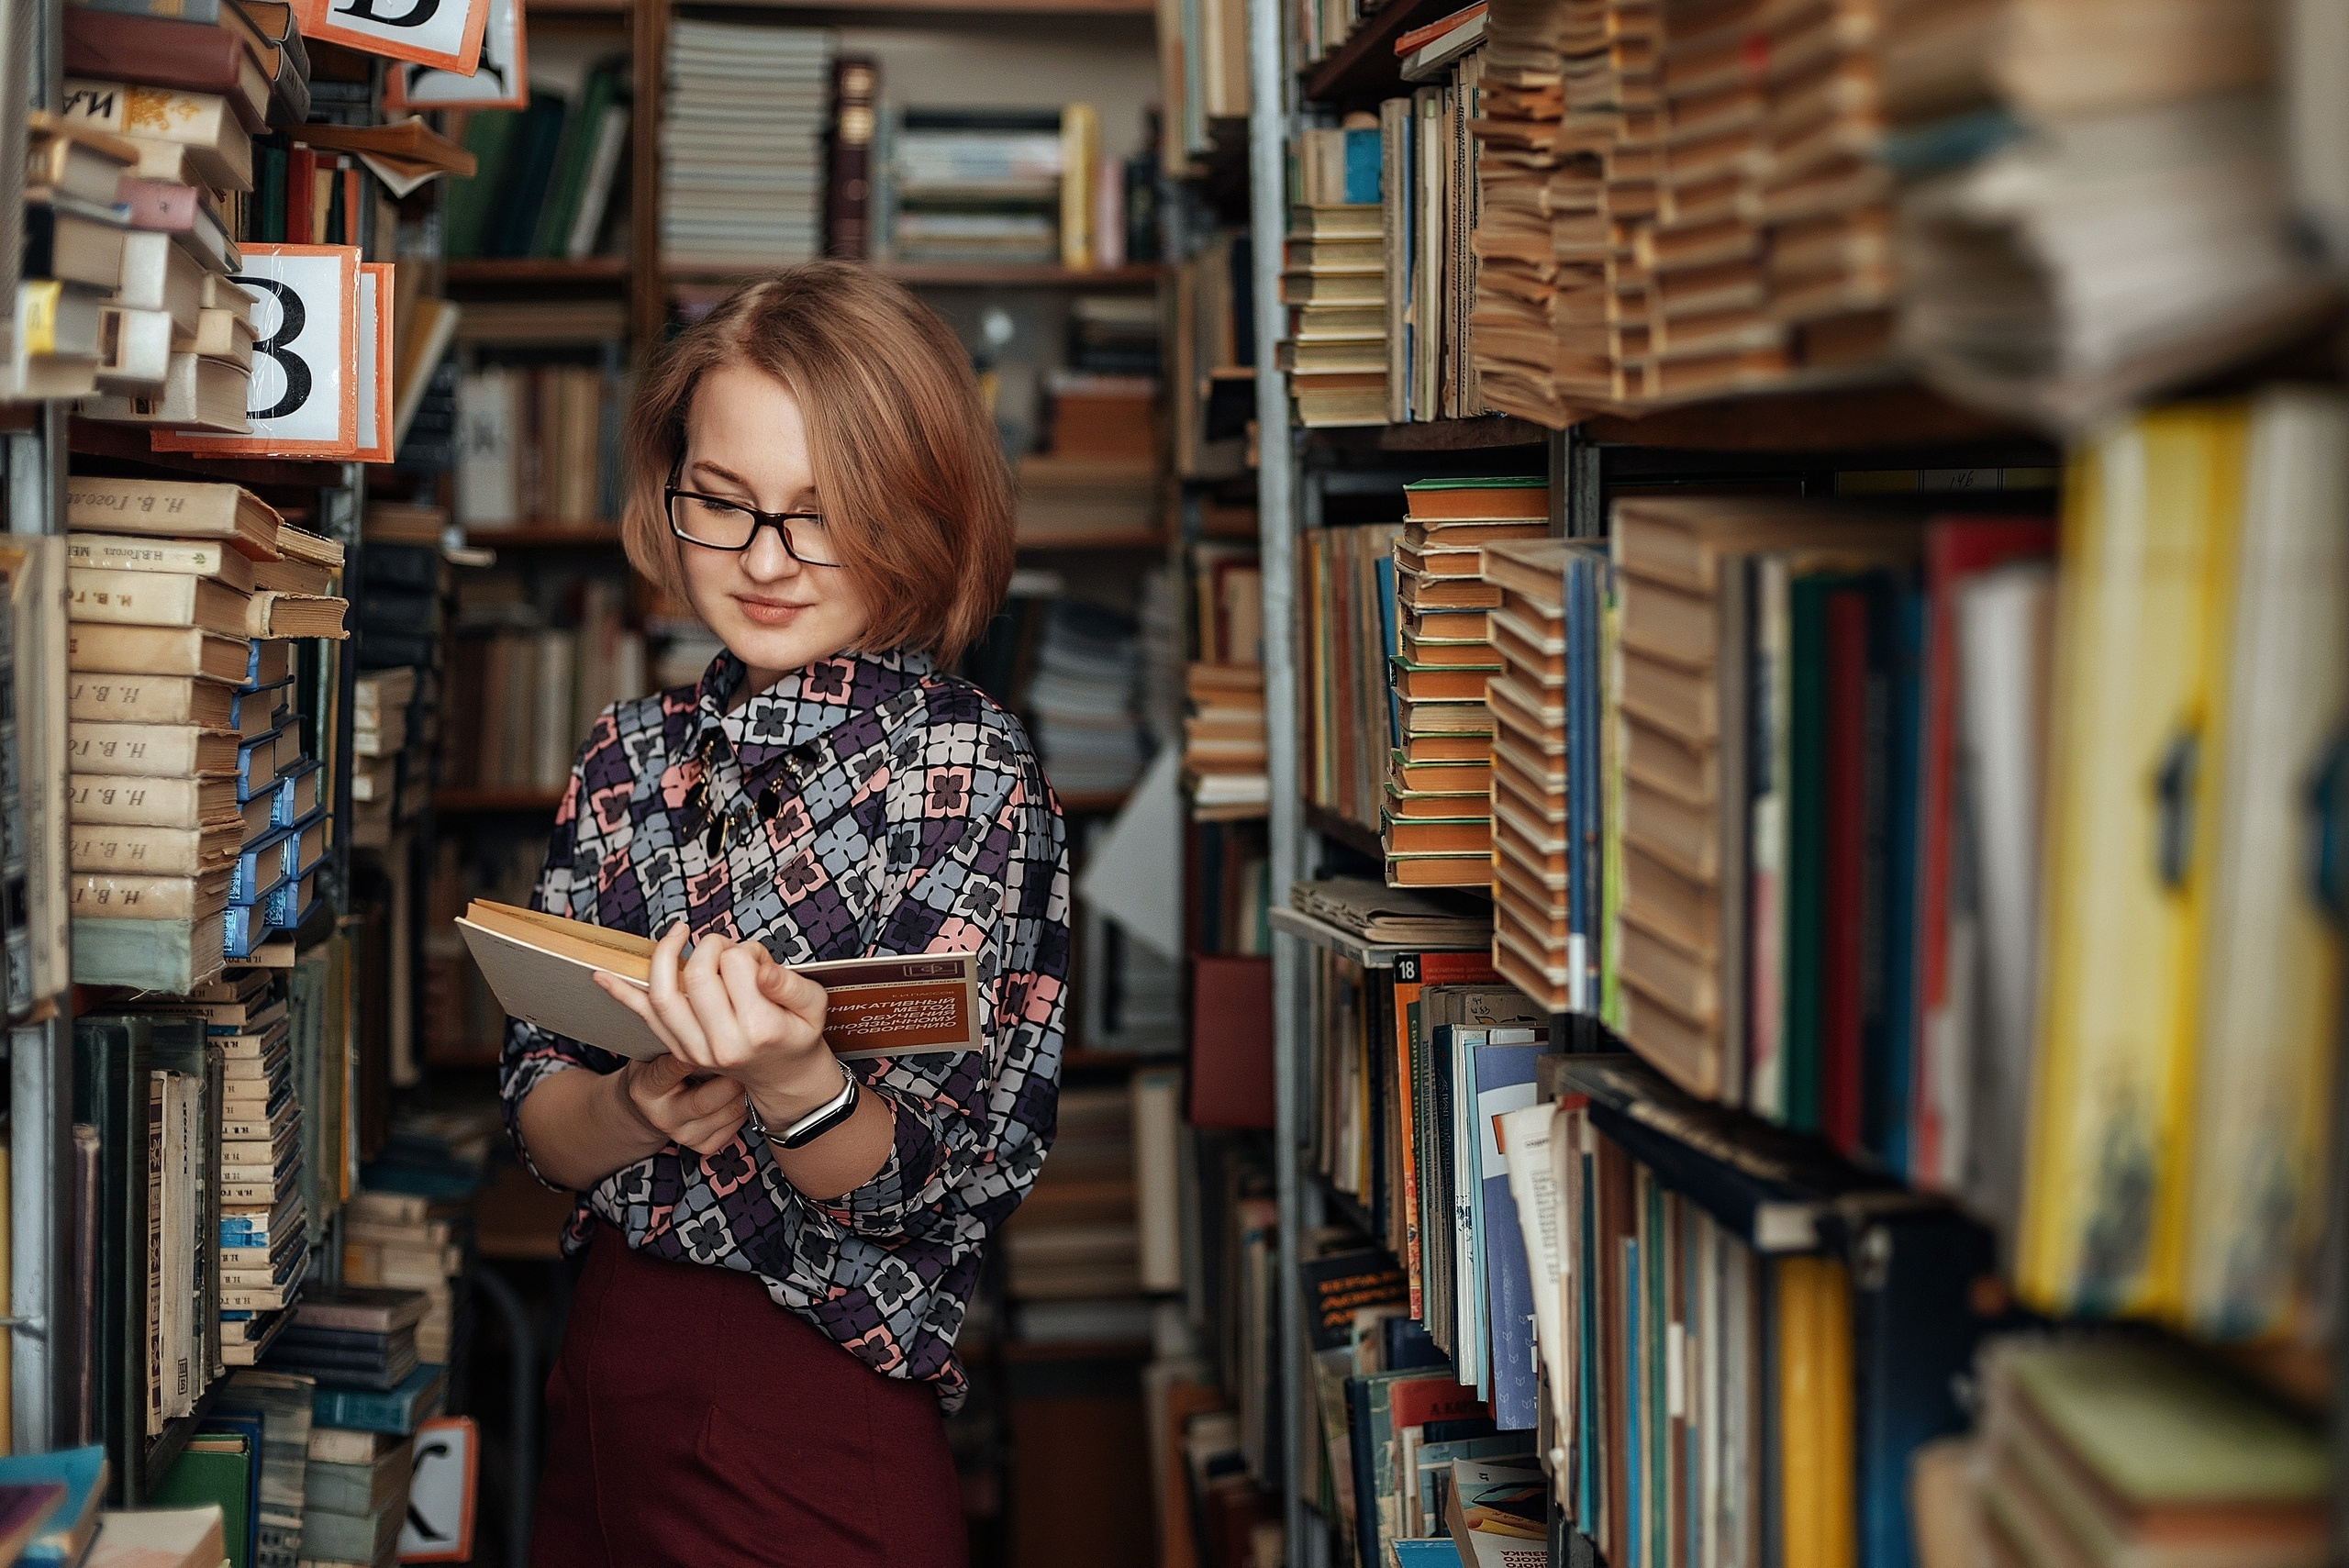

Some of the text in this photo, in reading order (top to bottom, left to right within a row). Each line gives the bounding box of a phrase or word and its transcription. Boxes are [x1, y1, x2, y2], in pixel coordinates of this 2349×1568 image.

[138, 495, 155, 512] В.
[164, 496, 184, 513] Н.
[93, 685, 109, 702] В.
[120, 686, 139, 704] Н.
[99, 740, 117, 757] В.
[127, 741, 147, 759] Н.
[98, 788, 116, 805] В.
[126, 789, 145, 806] Н.
[99, 841, 117, 858] В.
[128, 842, 147, 860] Н.
[94, 888, 110, 904] В.
[120, 889, 139, 905] Н.
[1399, 961, 1415, 979] 18
[861, 1009, 955, 1022] ОБУЧЕНИЯ
[893, 1004, 955, 1013] МЕТОД
[847, 1021, 957, 1036] ГОВОРЕНИЮ
